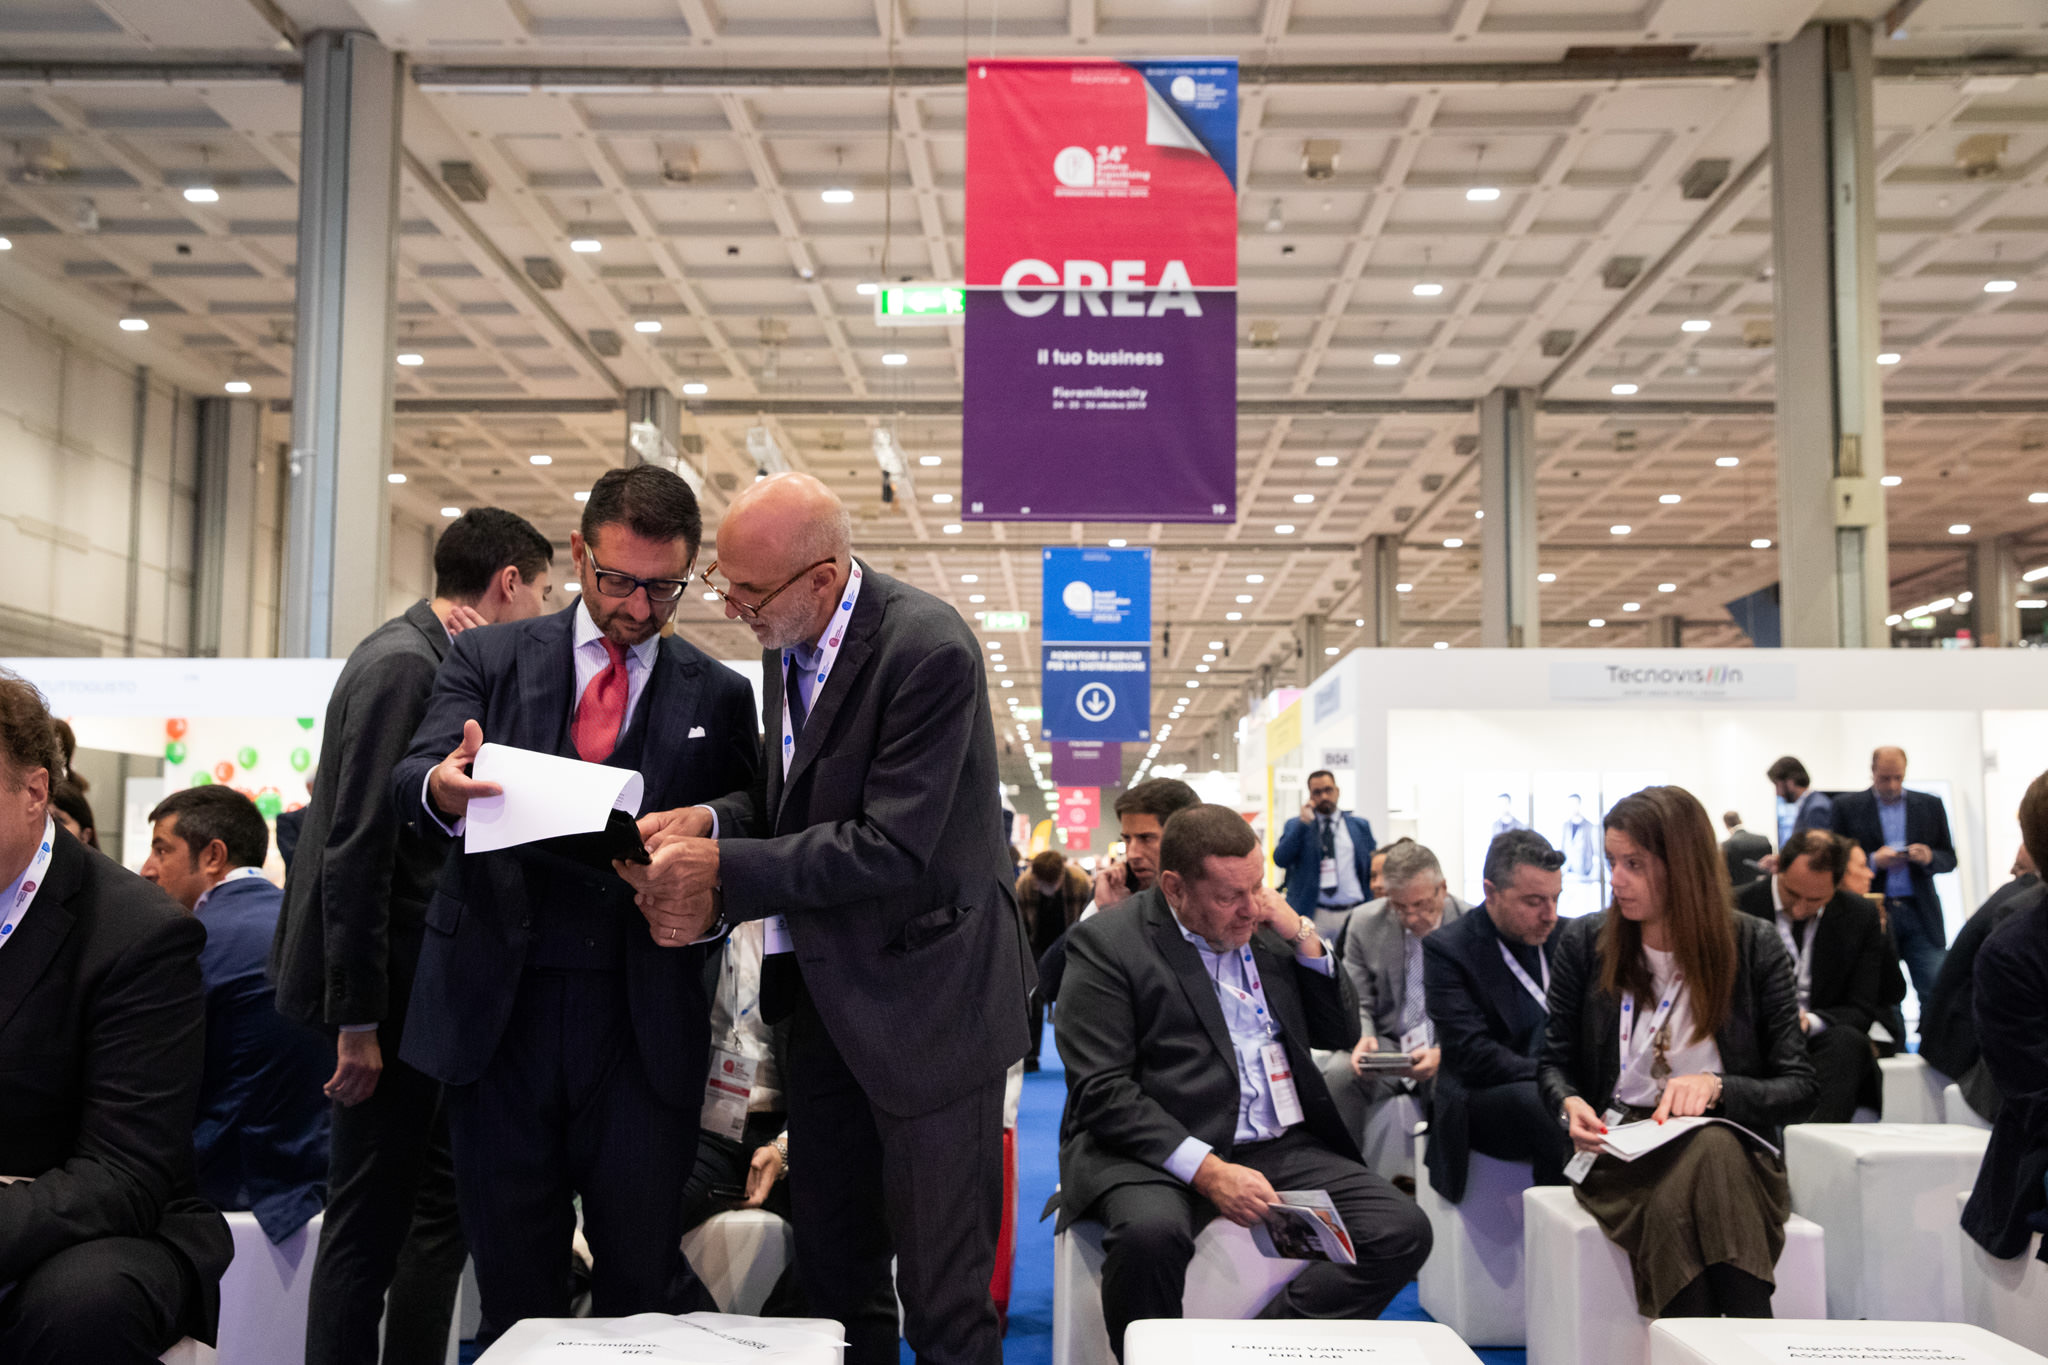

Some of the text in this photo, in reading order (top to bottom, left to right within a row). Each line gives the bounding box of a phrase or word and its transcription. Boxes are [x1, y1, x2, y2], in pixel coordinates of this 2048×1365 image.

[1000, 258, 1203, 317] CREA
[1052, 348, 1083, 366] tuo
[1086, 348, 1164, 366] business
